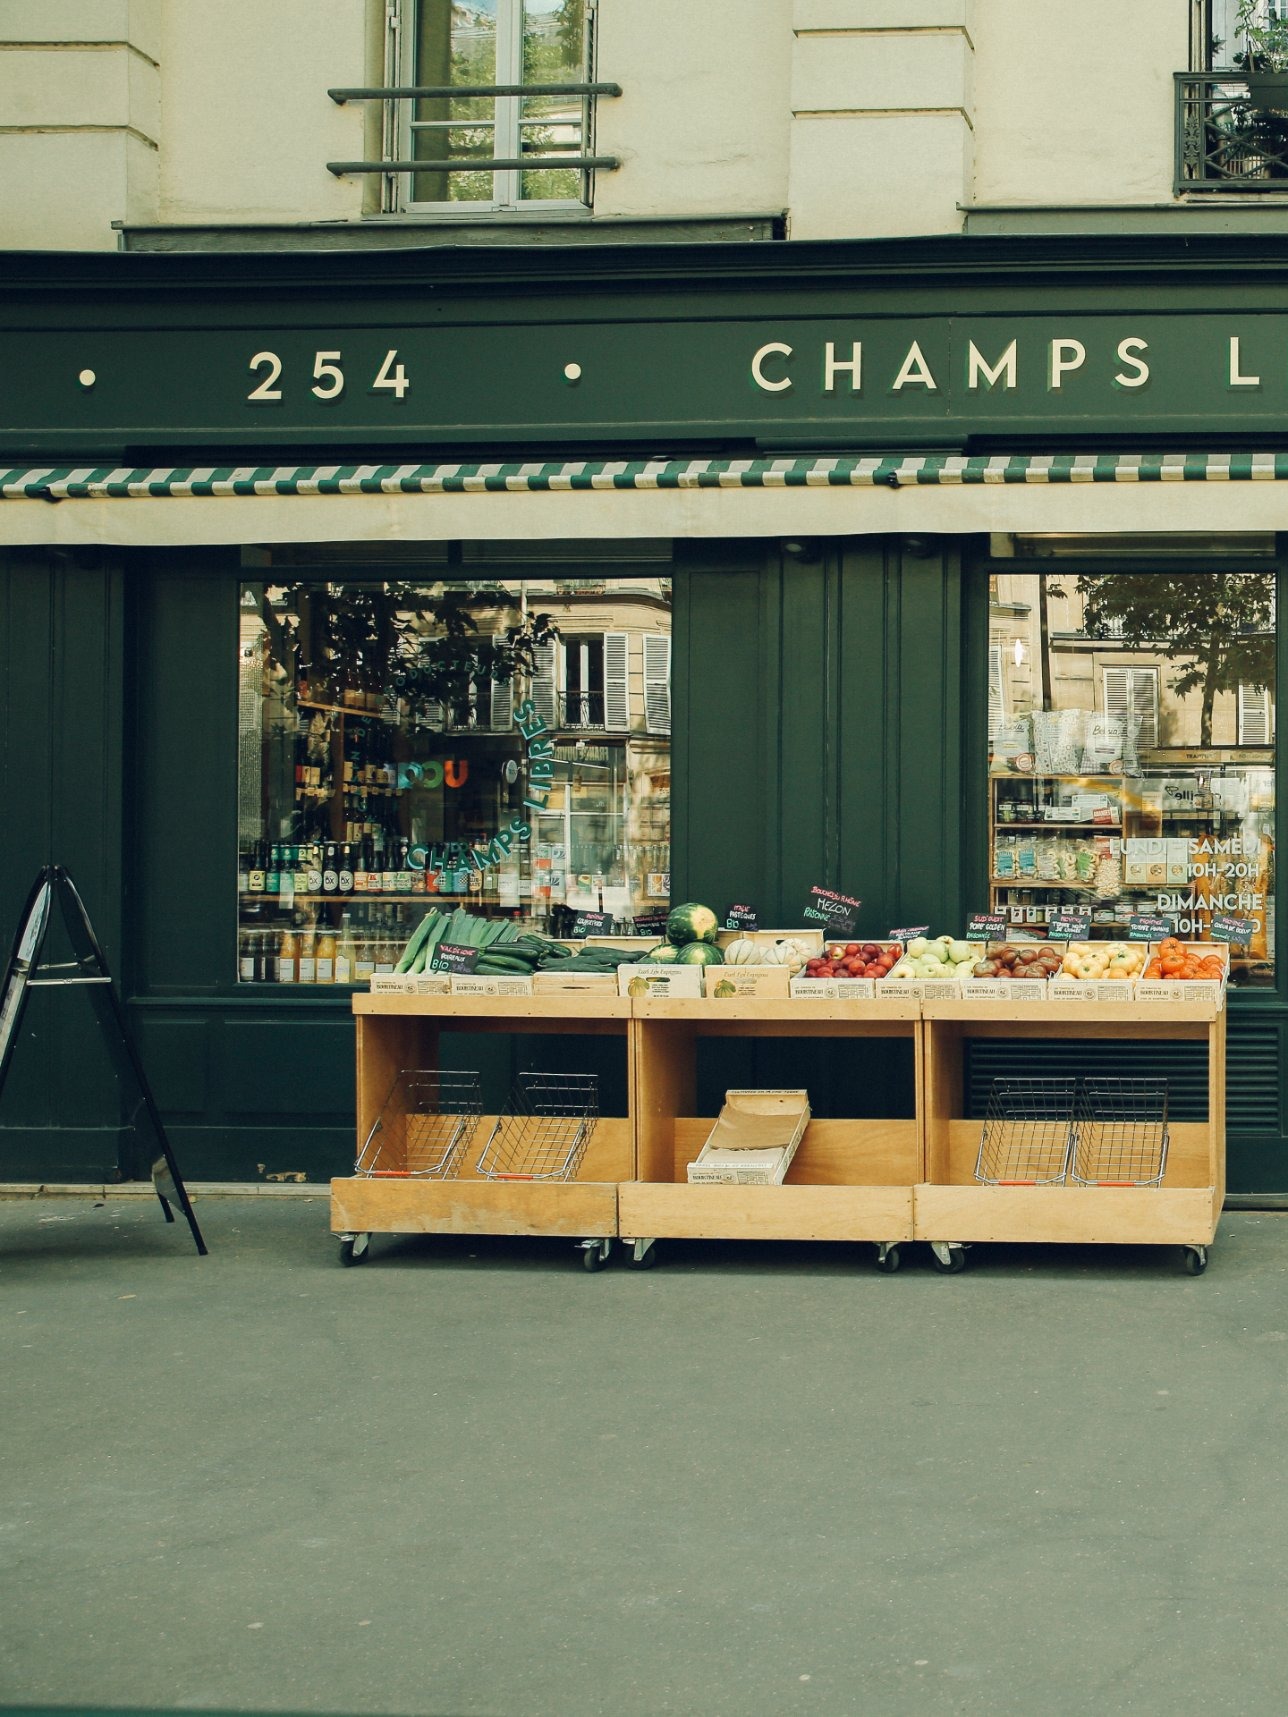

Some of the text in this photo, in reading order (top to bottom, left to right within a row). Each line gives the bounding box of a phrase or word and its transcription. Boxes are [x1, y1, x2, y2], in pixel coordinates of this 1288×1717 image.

[751, 337, 1150, 392] CHAMPS
[247, 350, 410, 400] 254
[406, 700, 554, 875] CHAMPS LIBRES
[1187, 862, 1260, 877] 10H-20H
[817, 897, 851, 916] MELON
[1157, 893, 1263, 910] DIMANCHE
[431, 958, 450, 970] BIO
